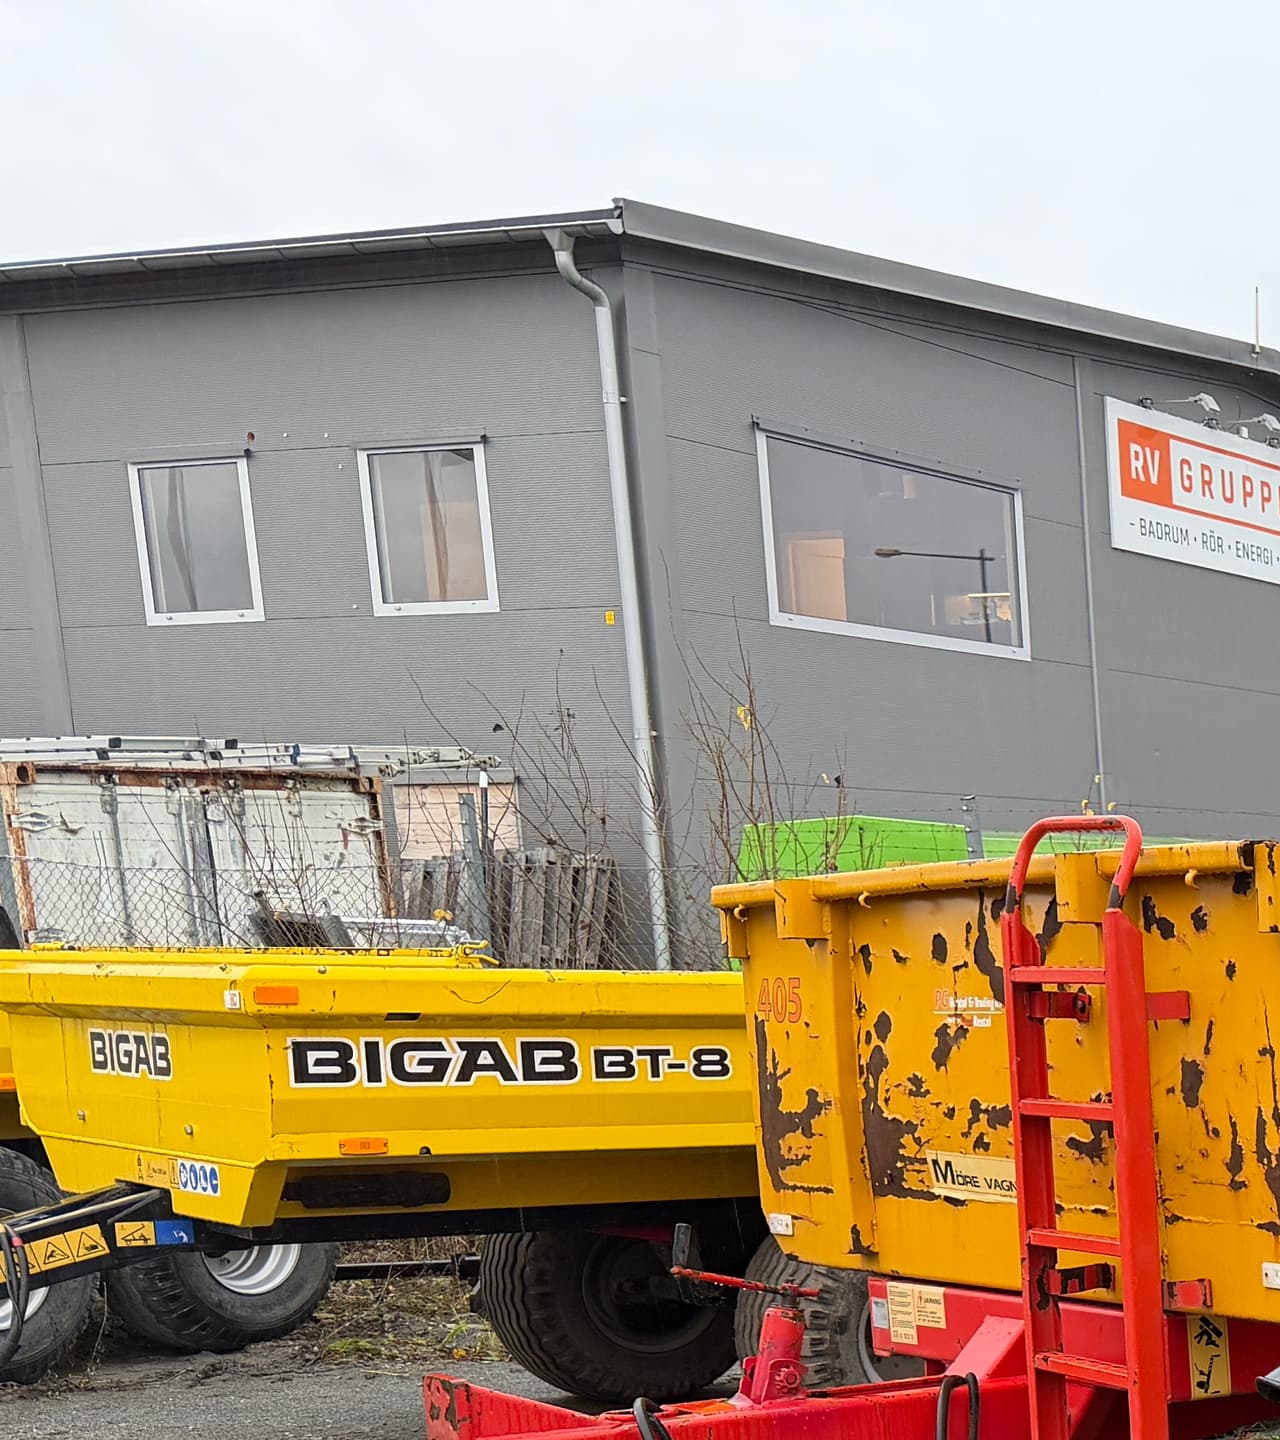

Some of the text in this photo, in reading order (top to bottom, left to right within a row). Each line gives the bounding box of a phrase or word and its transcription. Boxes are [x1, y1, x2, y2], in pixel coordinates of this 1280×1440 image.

[1129, 443, 1160, 485] RV
[1139, 518, 1190, 546] BADRUM
[1202, 530, 1225, 554] RÖR
[1236, 540, 1274, 566] ENERGI
[758, 977, 802, 1023] 405
[89, 1031, 172, 1077] BIGAB
[290, 1040, 730, 1083] BIGAB BT-8
[931, 1158, 980, 1188] MÖRE
